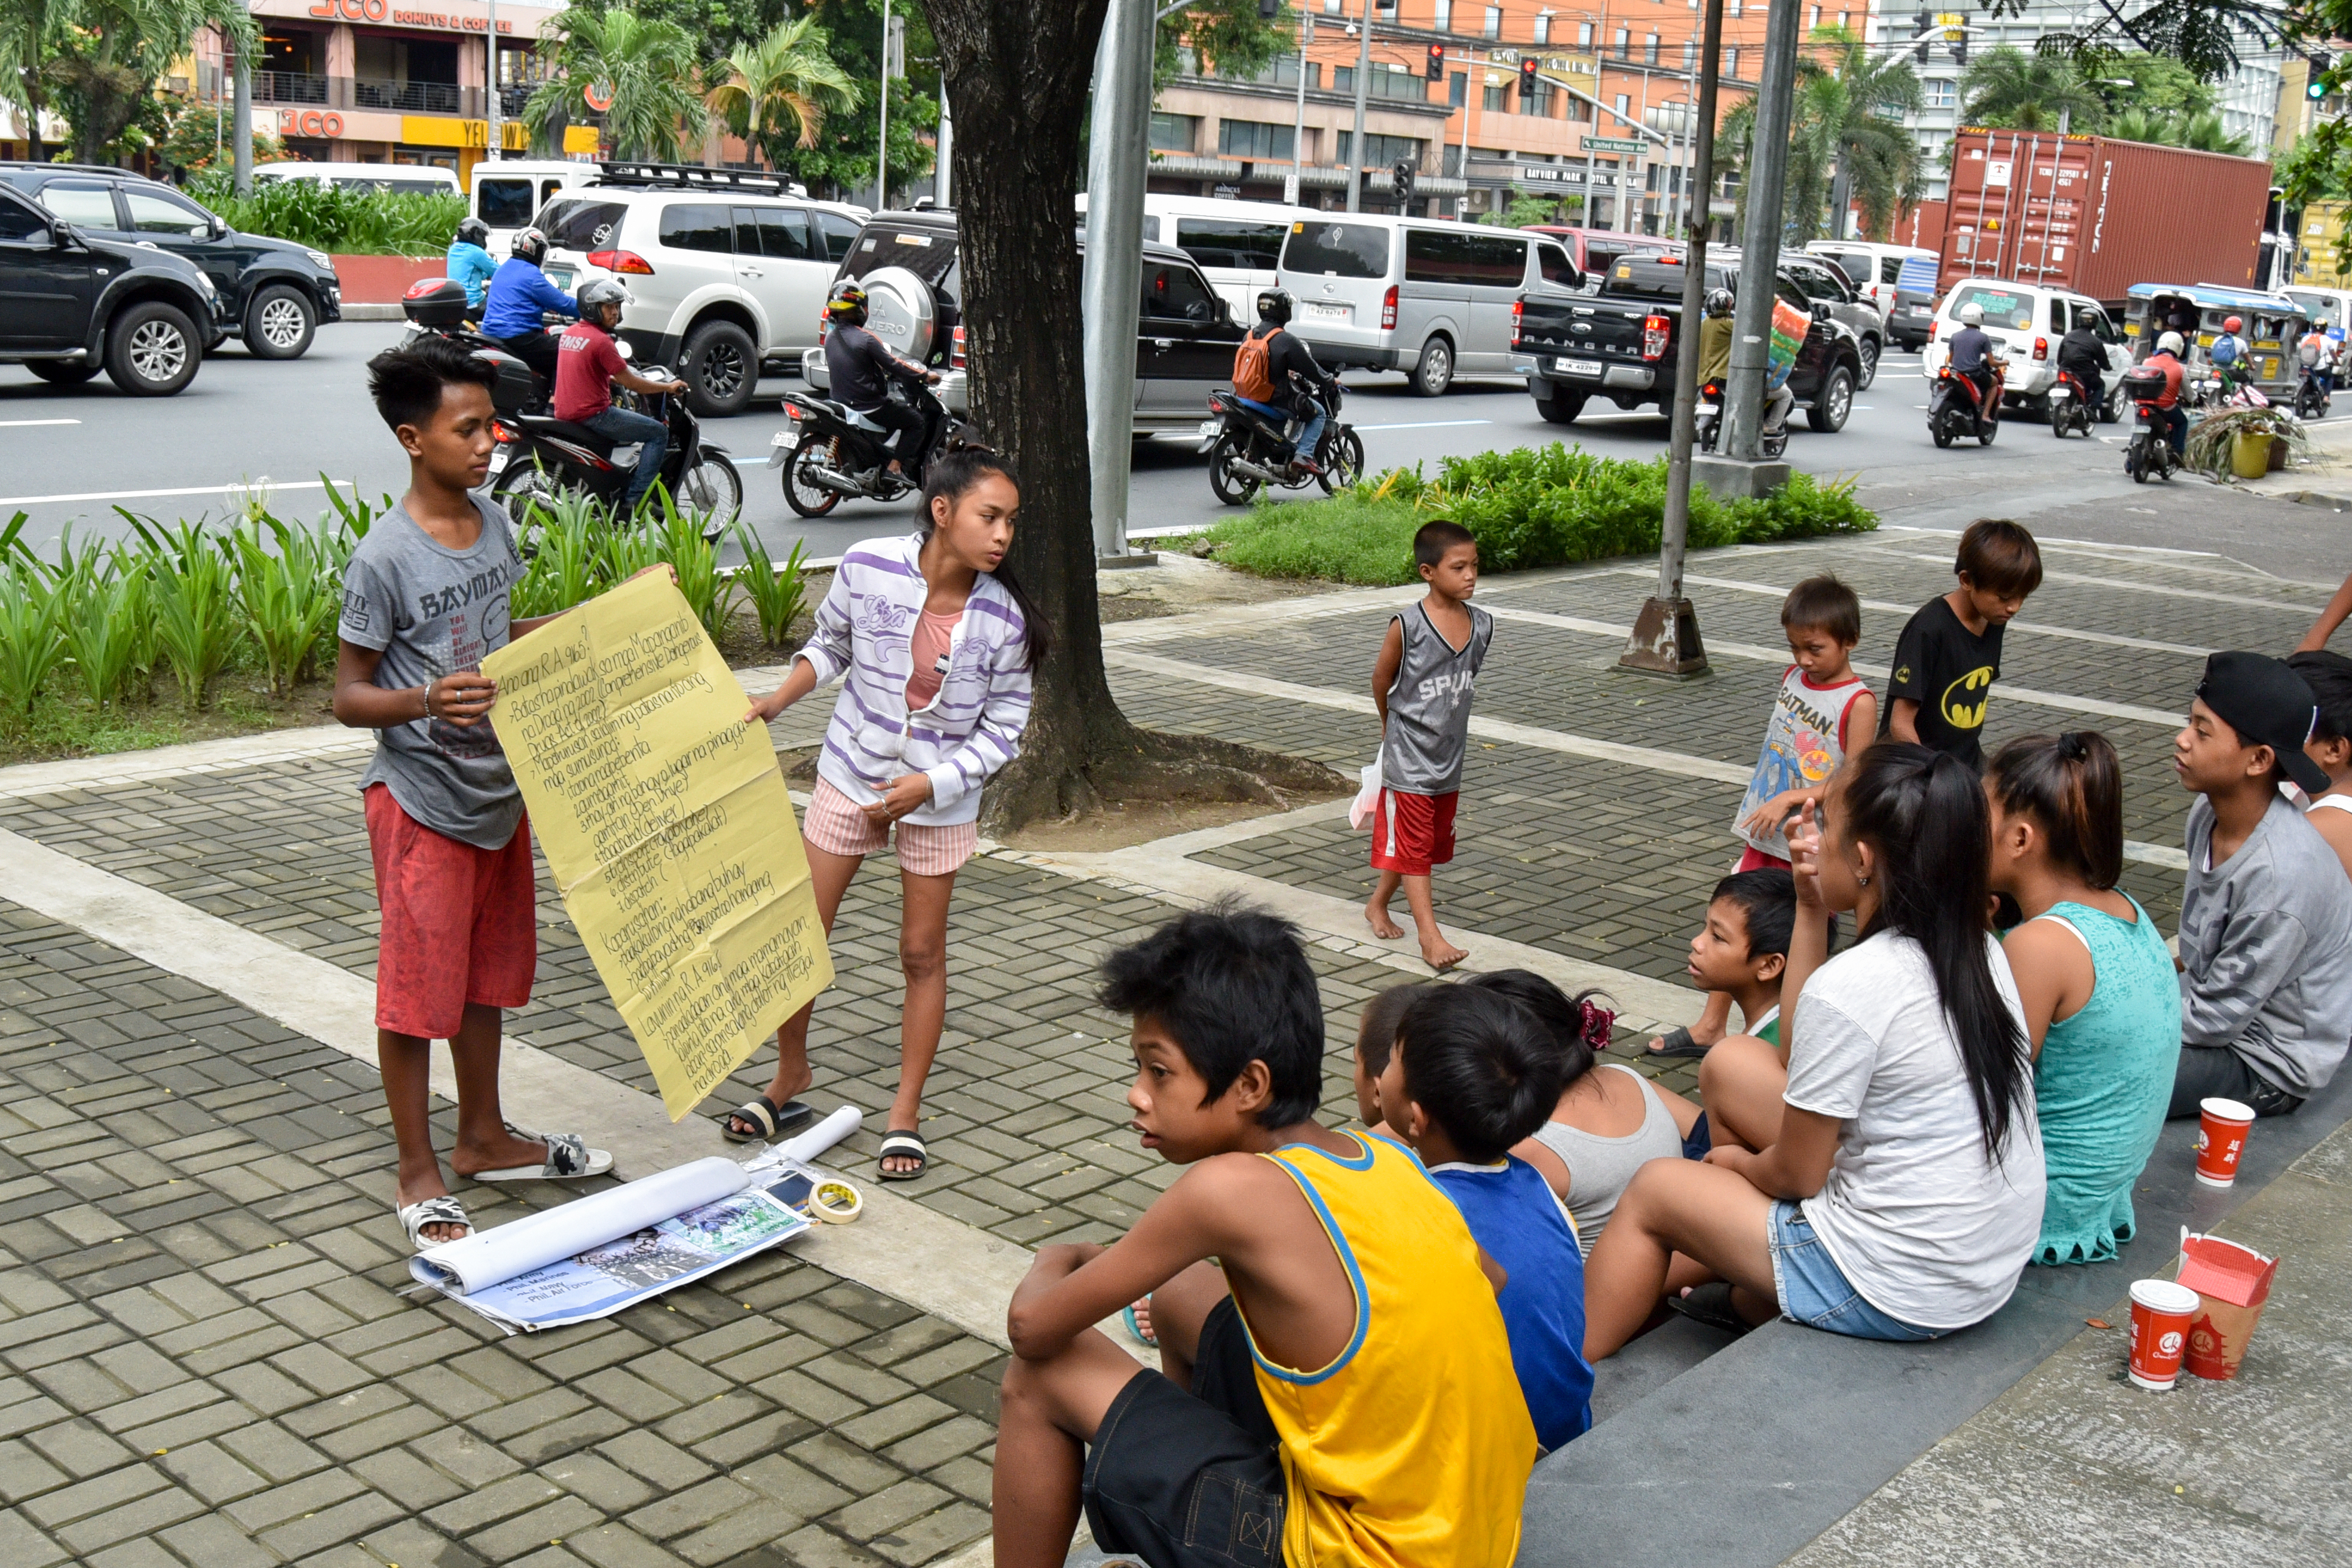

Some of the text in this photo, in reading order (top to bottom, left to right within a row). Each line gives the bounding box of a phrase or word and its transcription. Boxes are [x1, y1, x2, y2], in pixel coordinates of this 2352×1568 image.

[394, 10, 447, 26] DONUTS
[451, 16, 460, 29] &
[463, 17, 512, 33] COFEE
[1592, 140, 1647, 153] United Nations Ave
[1527, 168, 1637, 187] BAYVIEW PARK OTEL MILA
[866, 320, 906, 336] JERO
[1524, 334, 1638, 355] RANGER
[419, 559, 510, 620] BAYMAX
[449, 614, 464, 625] YOU
[451, 623, 468, 635] WILL
[452, 636, 462, 647] BE
[455, 652, 476, 667] THERE
[496, 675, 520, 700] Ano
[521, 665, 542, 694] ang
[510, 694, 541, 722] Batas
[618, 710, 641, 731] ng
[630, 697, 662, 719] batas
[681, 672, 713, 694] ang
[1777, 685, 1834, 736] BATMAN
[521, 724, 537, 742] na
[556, 721, 575, 743] Act
[529, 1271, 569, 1284] Marines
[550, 1288, 565, 1296] Air
